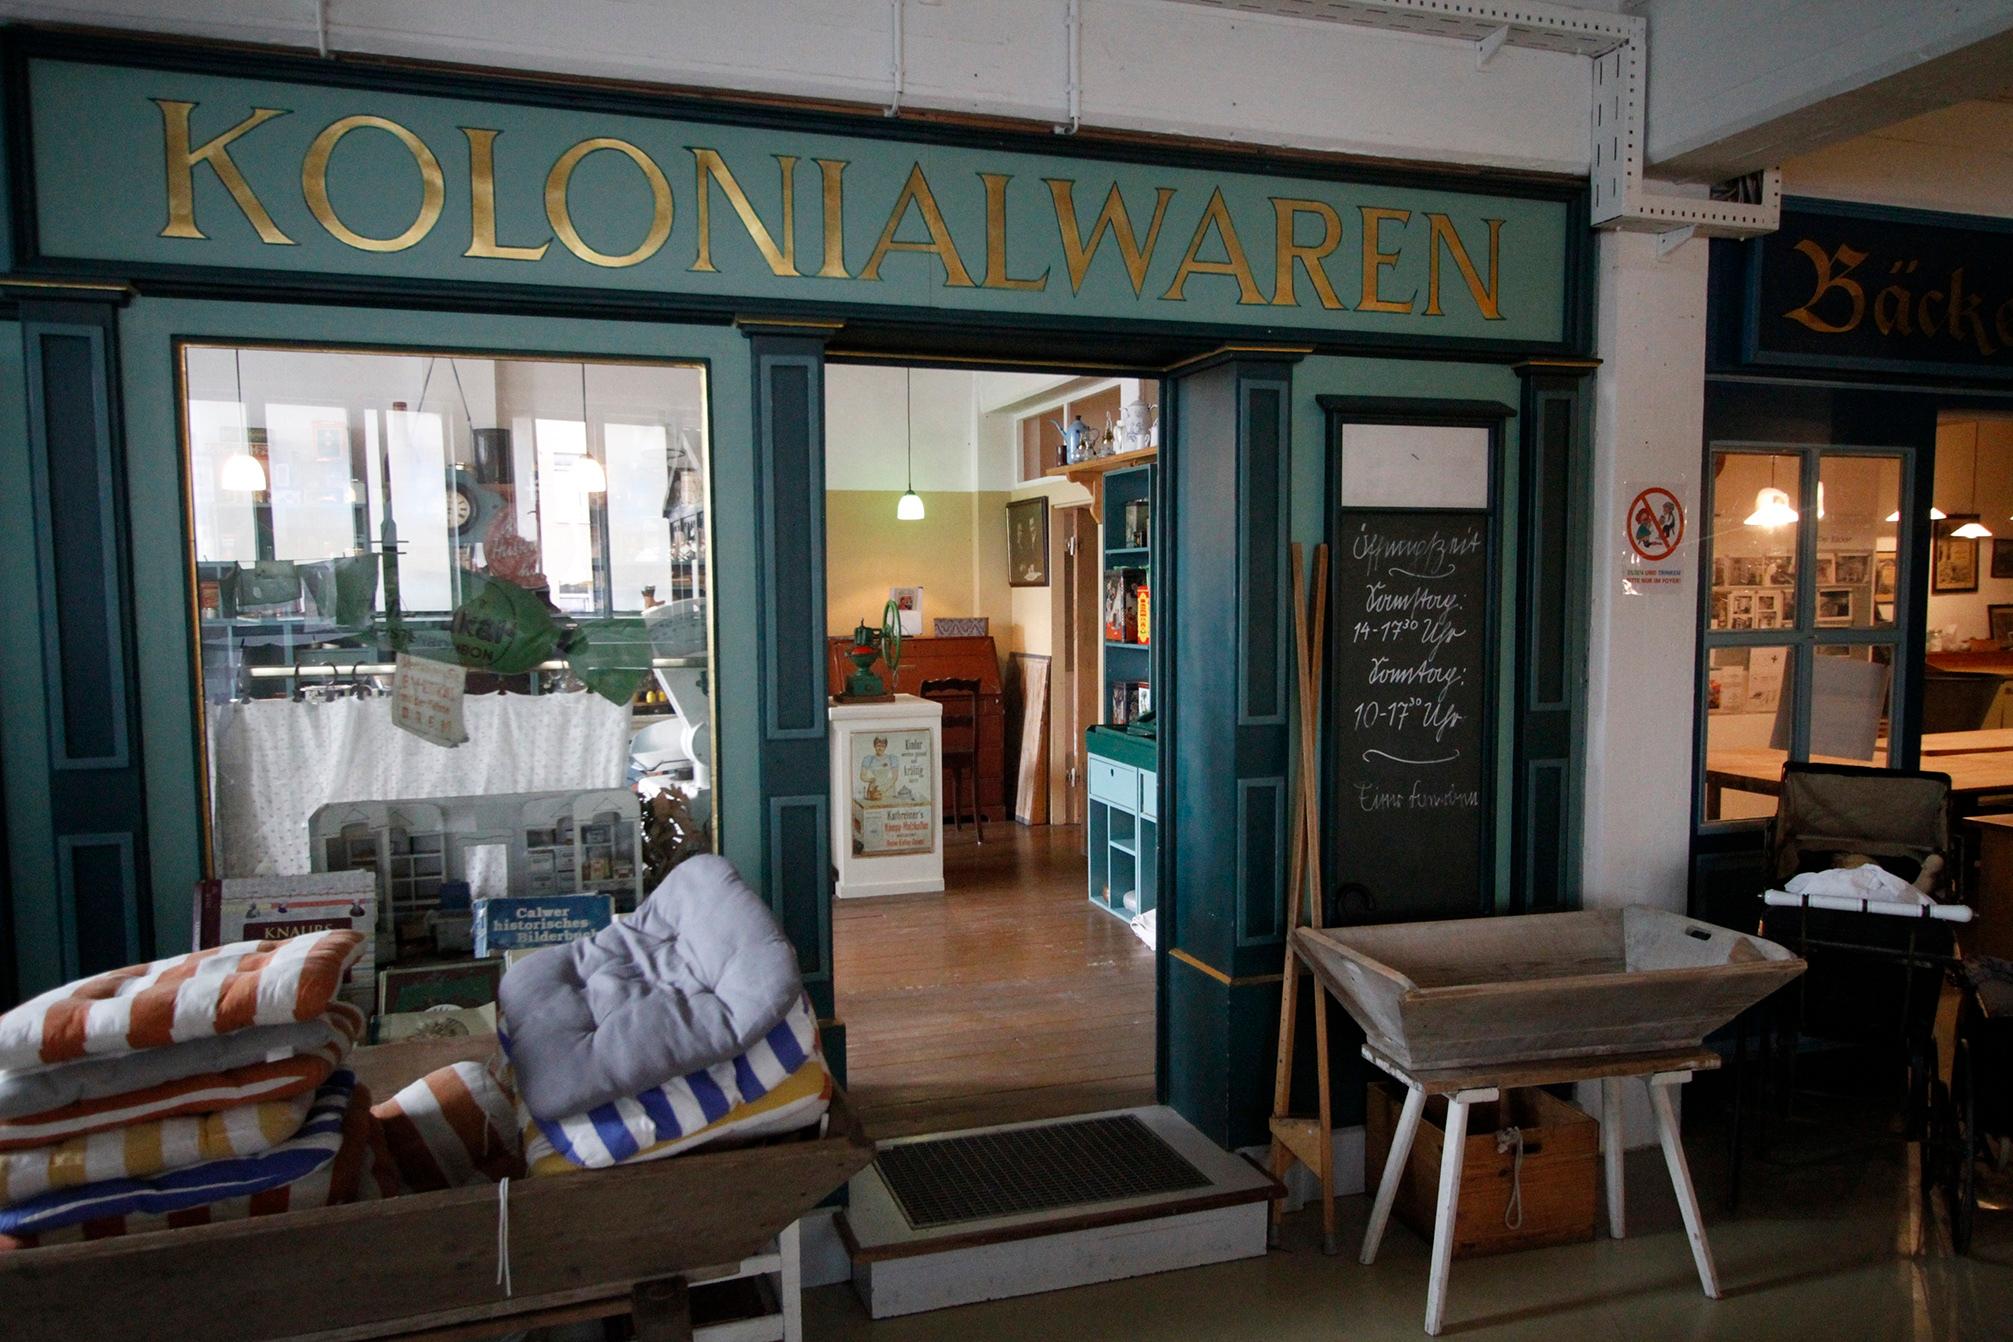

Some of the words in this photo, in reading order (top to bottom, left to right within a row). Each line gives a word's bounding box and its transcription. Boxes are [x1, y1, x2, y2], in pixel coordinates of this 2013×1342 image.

[150, 98, 1506, 322] KOLONIALWAREN
[515, 906, 570, 919] Calwer
[493, 917, 590, 932] historisches
